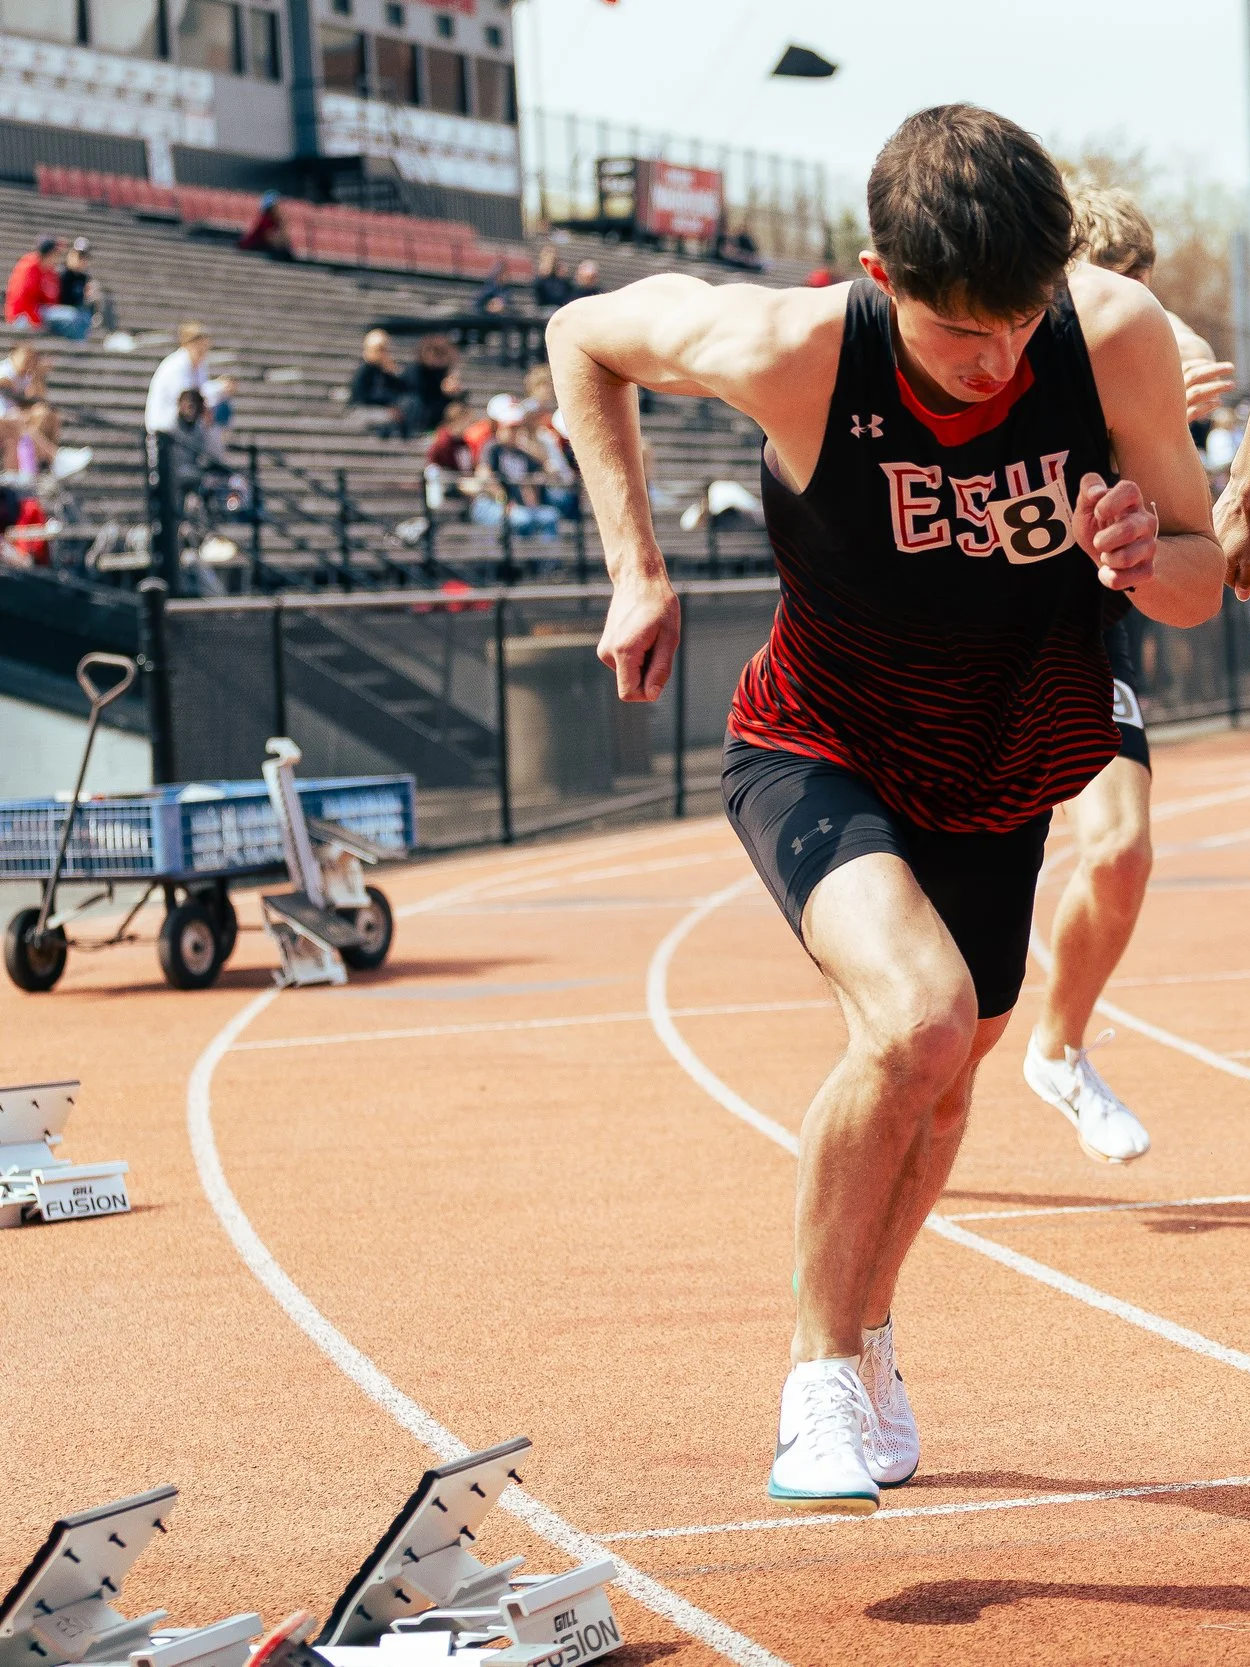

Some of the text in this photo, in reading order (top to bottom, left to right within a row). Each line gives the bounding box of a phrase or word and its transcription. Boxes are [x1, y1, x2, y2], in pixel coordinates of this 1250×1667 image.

[1003, 495, 1067, 557] 8
[46, 1193, 128, 1217] FUSION
[554, 1609, 578, 1632] GILL
